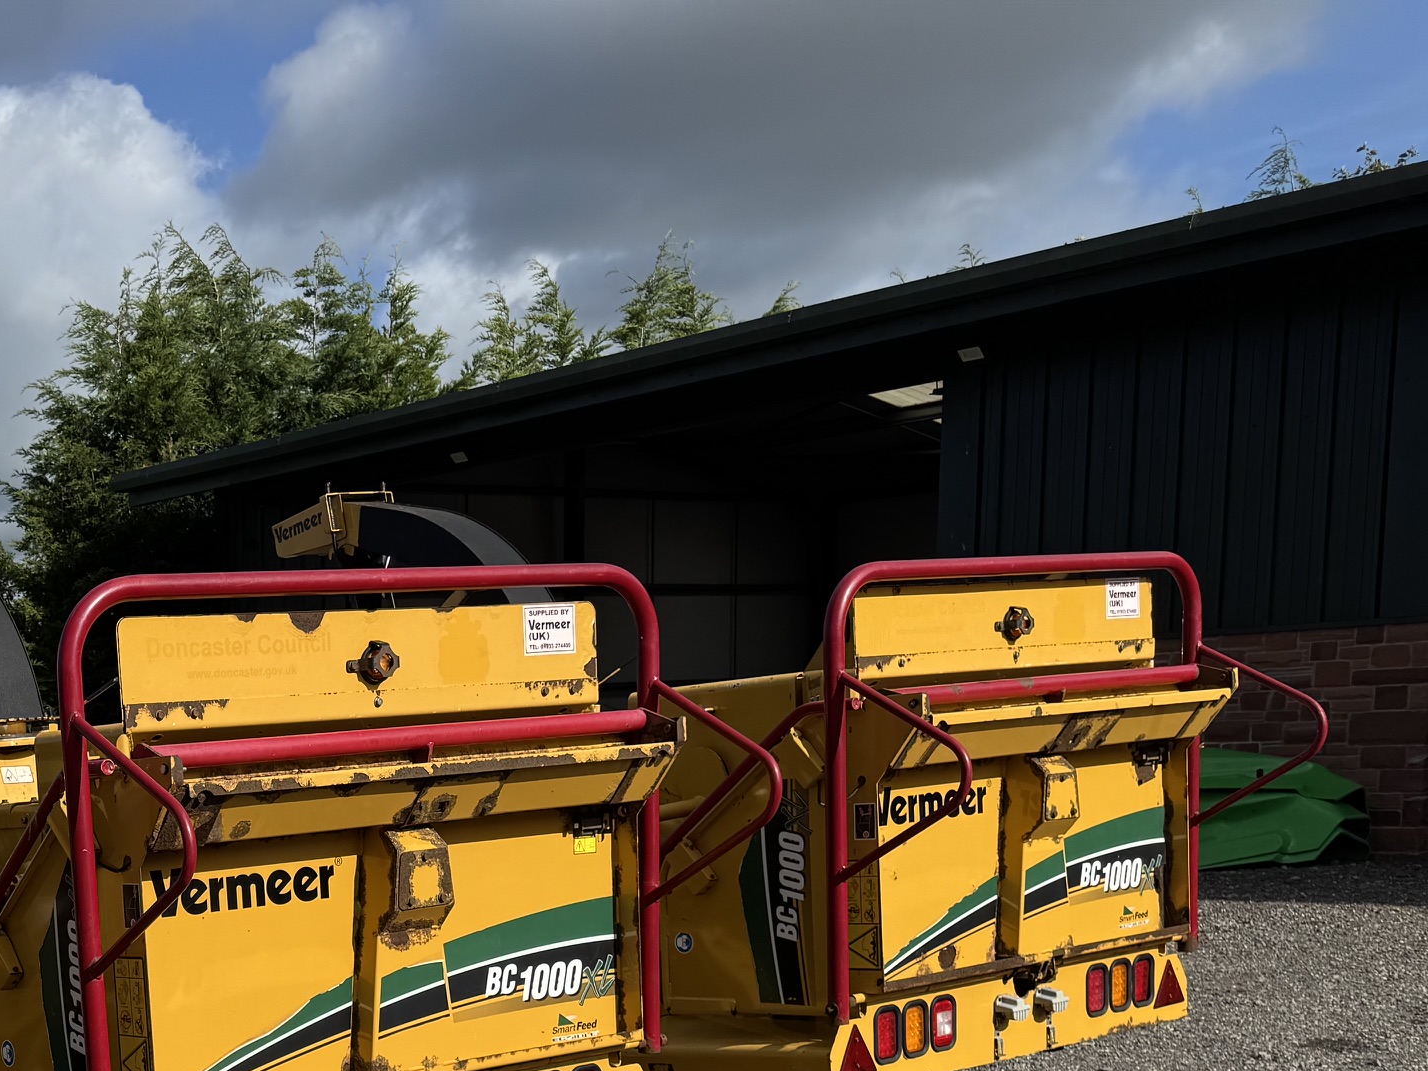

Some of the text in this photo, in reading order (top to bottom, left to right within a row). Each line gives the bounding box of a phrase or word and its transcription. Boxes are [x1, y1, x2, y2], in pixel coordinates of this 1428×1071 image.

[274, 511, 323, 543] Vermeer
[528, 619, 571, 630] Vermeer
[528, 632, 550, 641] (UK)
[146, 632, 332, 659] Doncaster Council
[186, 664, 297, 680] www.doncaster.gov.uk
